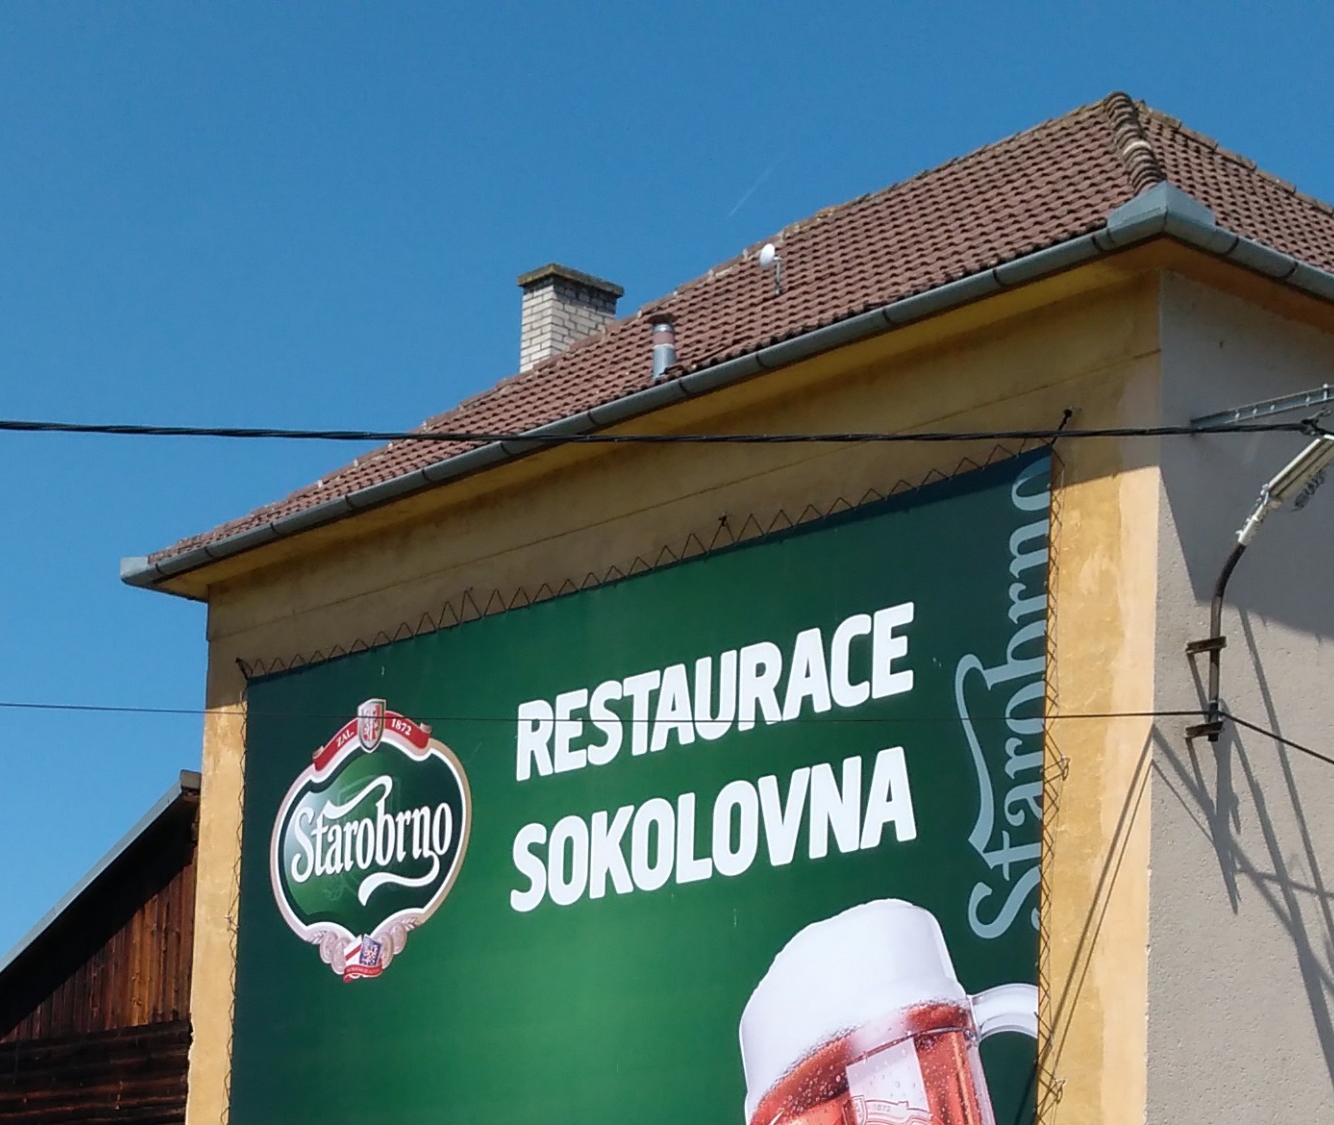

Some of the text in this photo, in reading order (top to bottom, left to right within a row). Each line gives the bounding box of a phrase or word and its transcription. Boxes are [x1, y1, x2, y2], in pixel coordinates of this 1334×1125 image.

[390, 718, 413, 736] 1872
[516, 602, 914, 781] RESTAURACE
[291, 775, 453, 906] Starobrno
[510, 746, 917, 912] SOKOLOVNA
